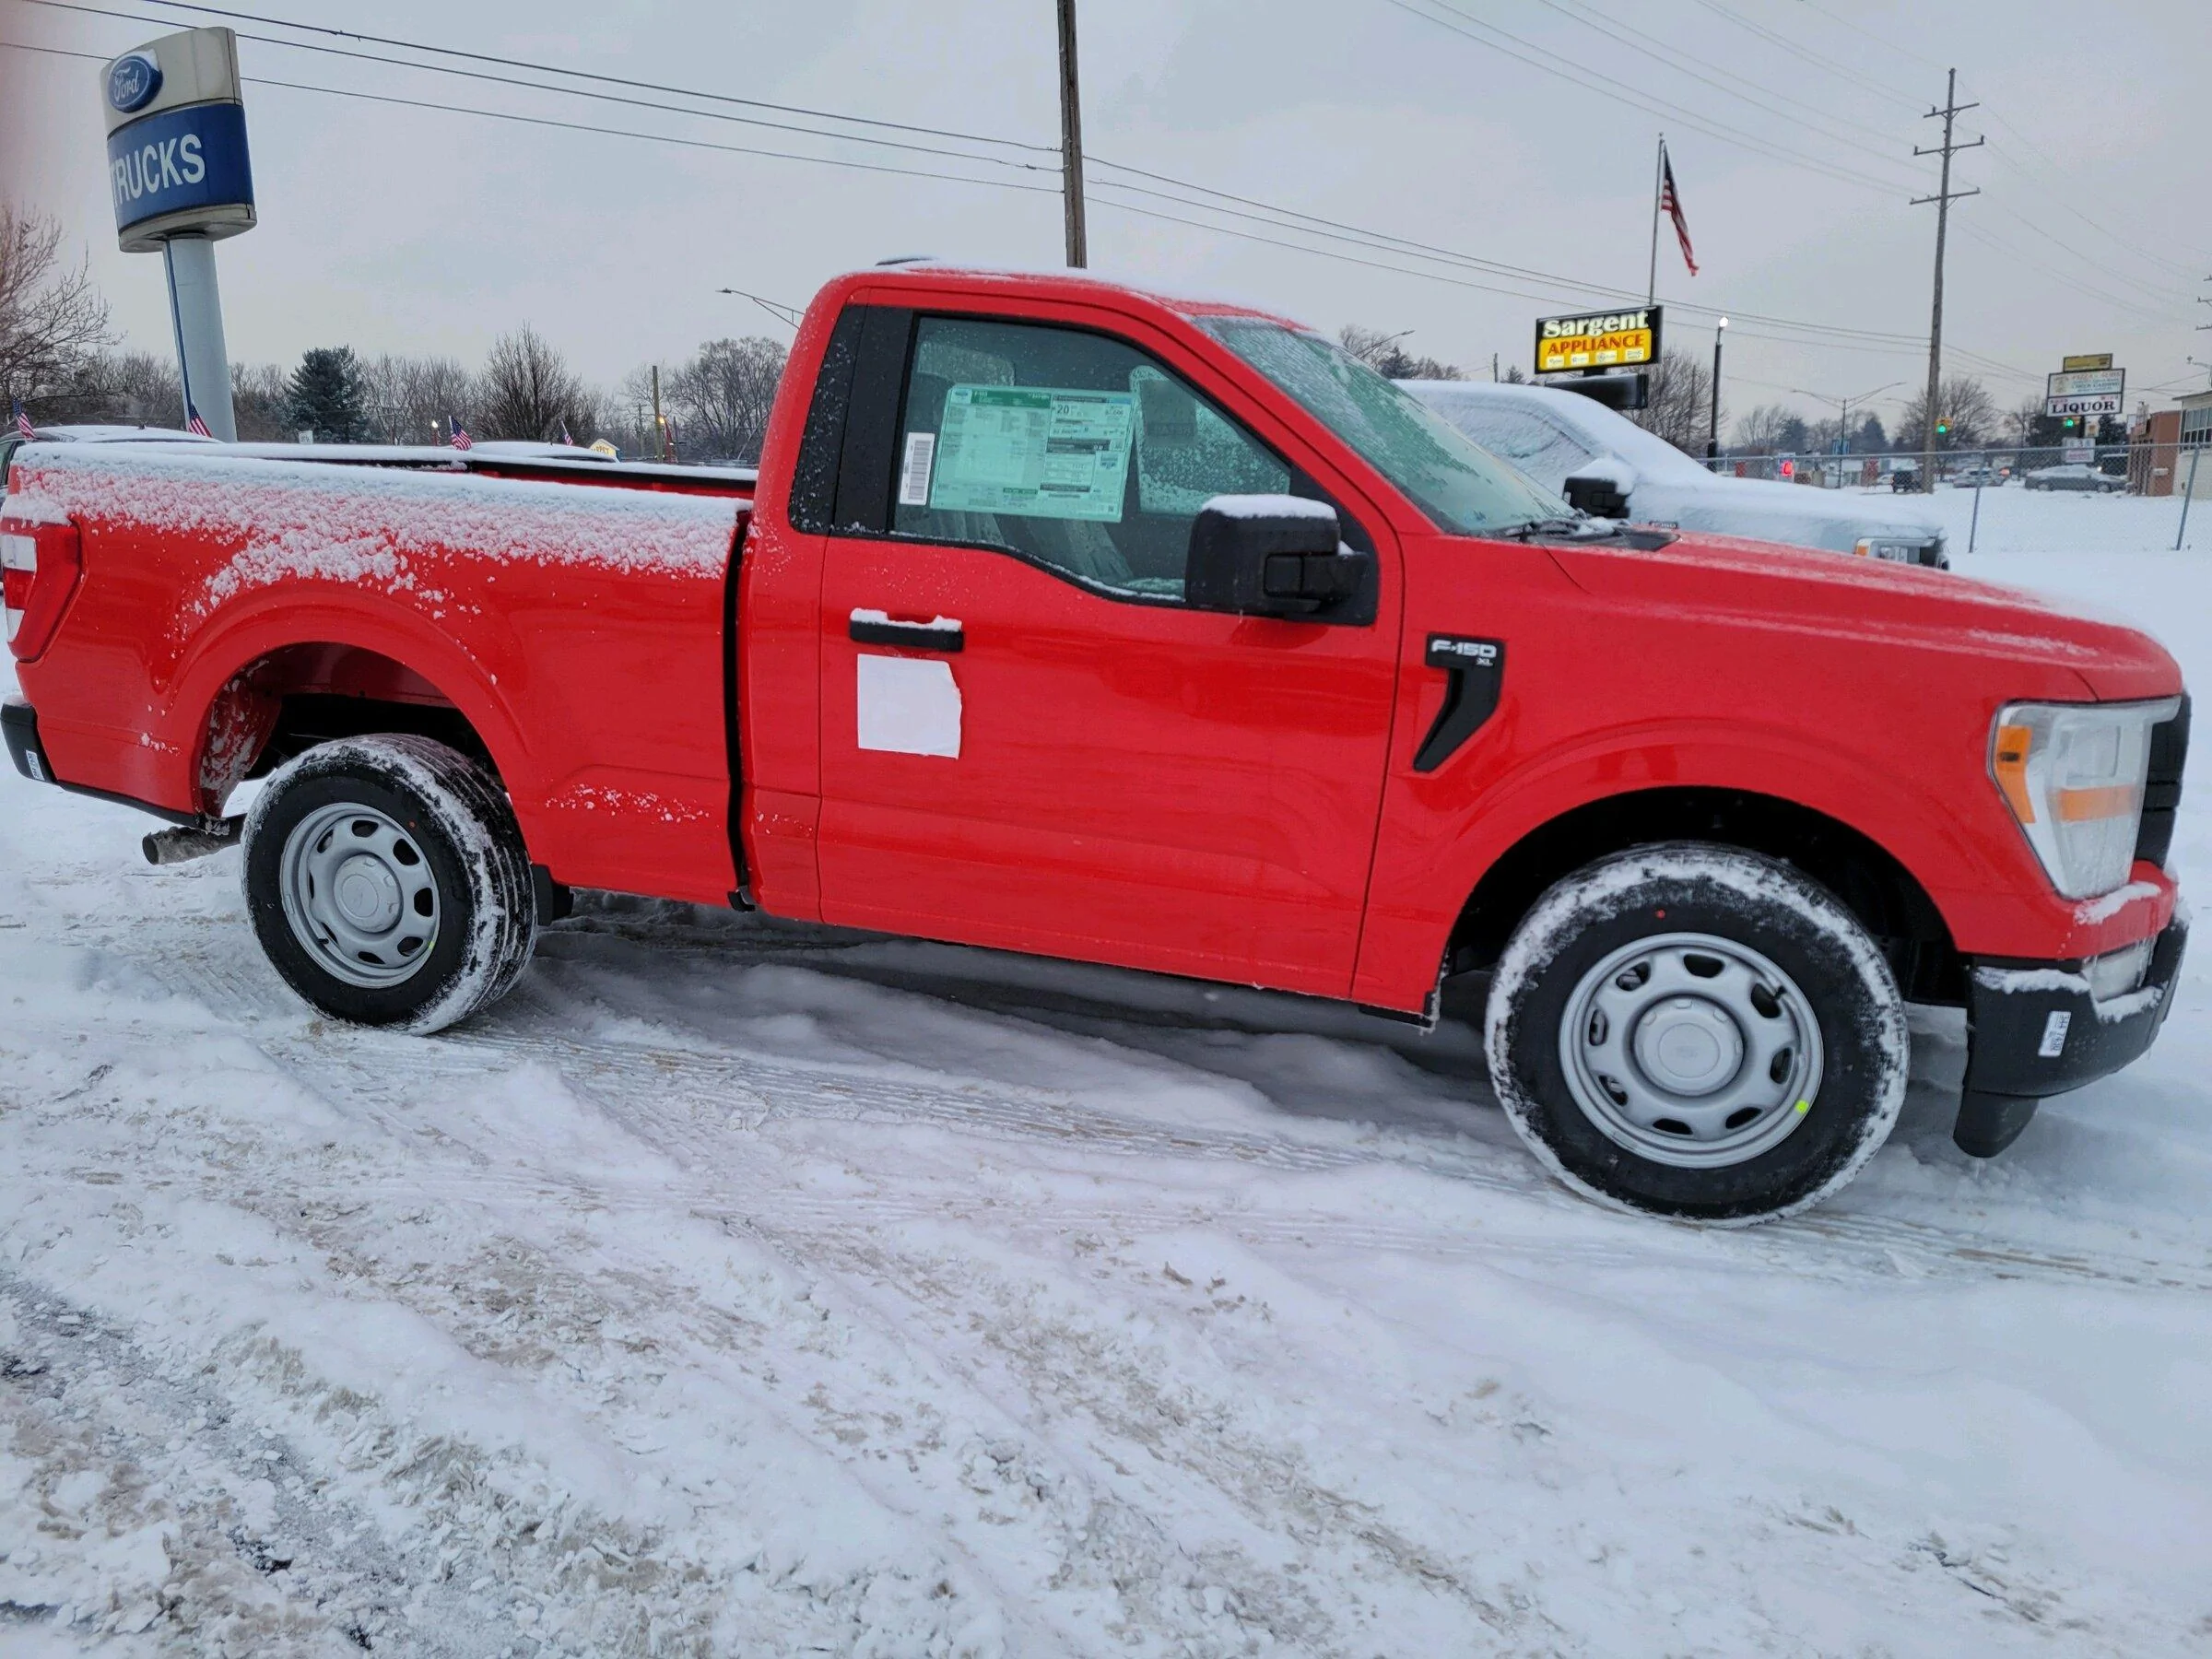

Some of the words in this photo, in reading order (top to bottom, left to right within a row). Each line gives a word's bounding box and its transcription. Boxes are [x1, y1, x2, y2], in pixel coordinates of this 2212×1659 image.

[113, 66, 139, 102] Ford
[111, 134, 206, 208] TRUCKS
[1542, 310, 1649, 338] Sargent
[1547, 333, 1645, 355] APPLIANCE
[2052, 401, 2115, 414] LIQUOR
[1431, 639, 1498, 659] F-150
[1476, 657, 1494, 666] XL
